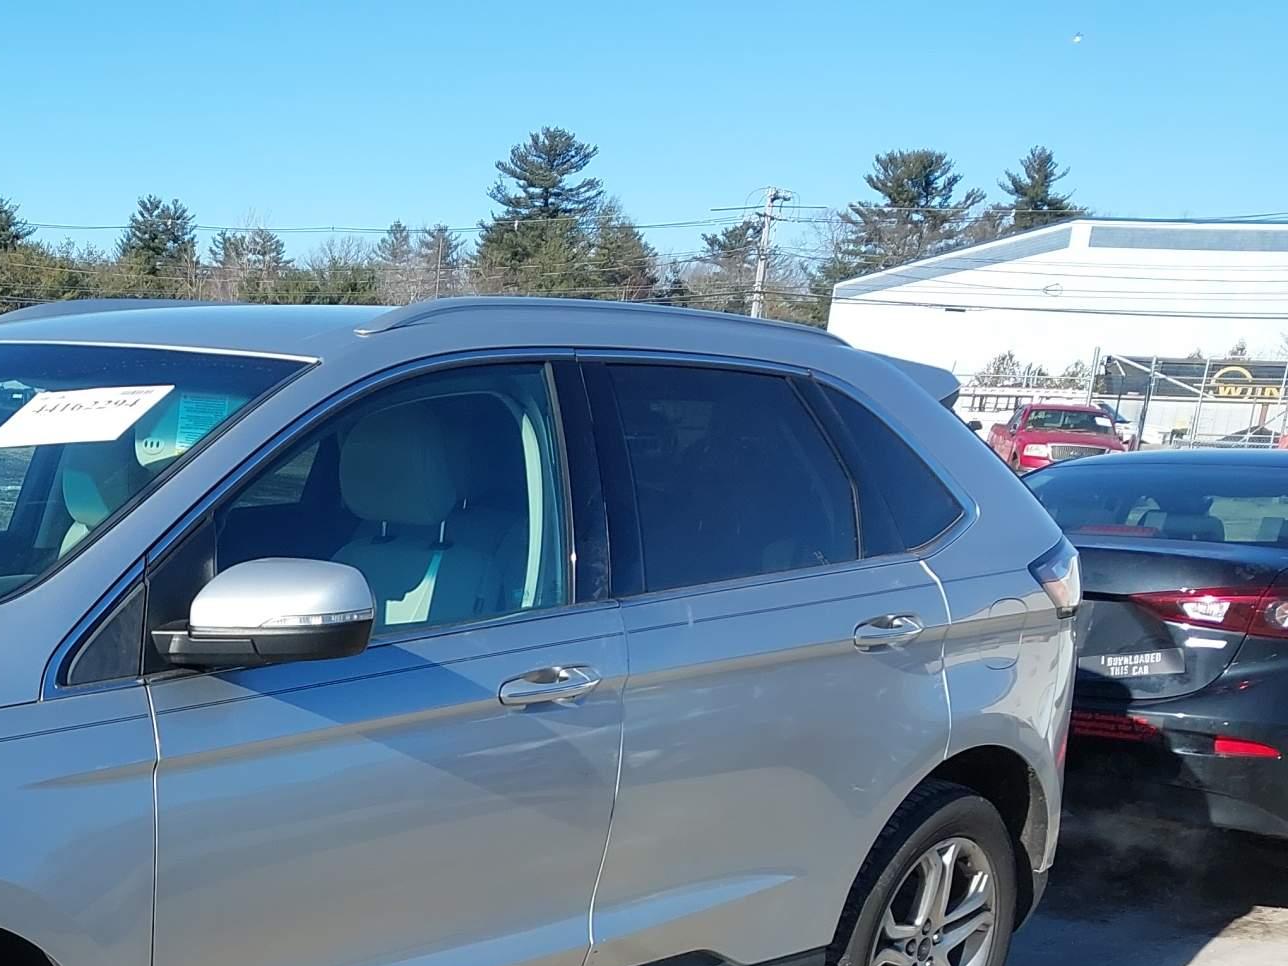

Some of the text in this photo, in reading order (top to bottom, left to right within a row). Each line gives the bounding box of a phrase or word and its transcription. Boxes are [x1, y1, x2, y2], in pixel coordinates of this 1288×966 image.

[32, 398, 142, 414] 44162294
[1101, 652, 1162, 666] I DOWNLOADED
[1111, 665, 1149, 676] THIS CAR
